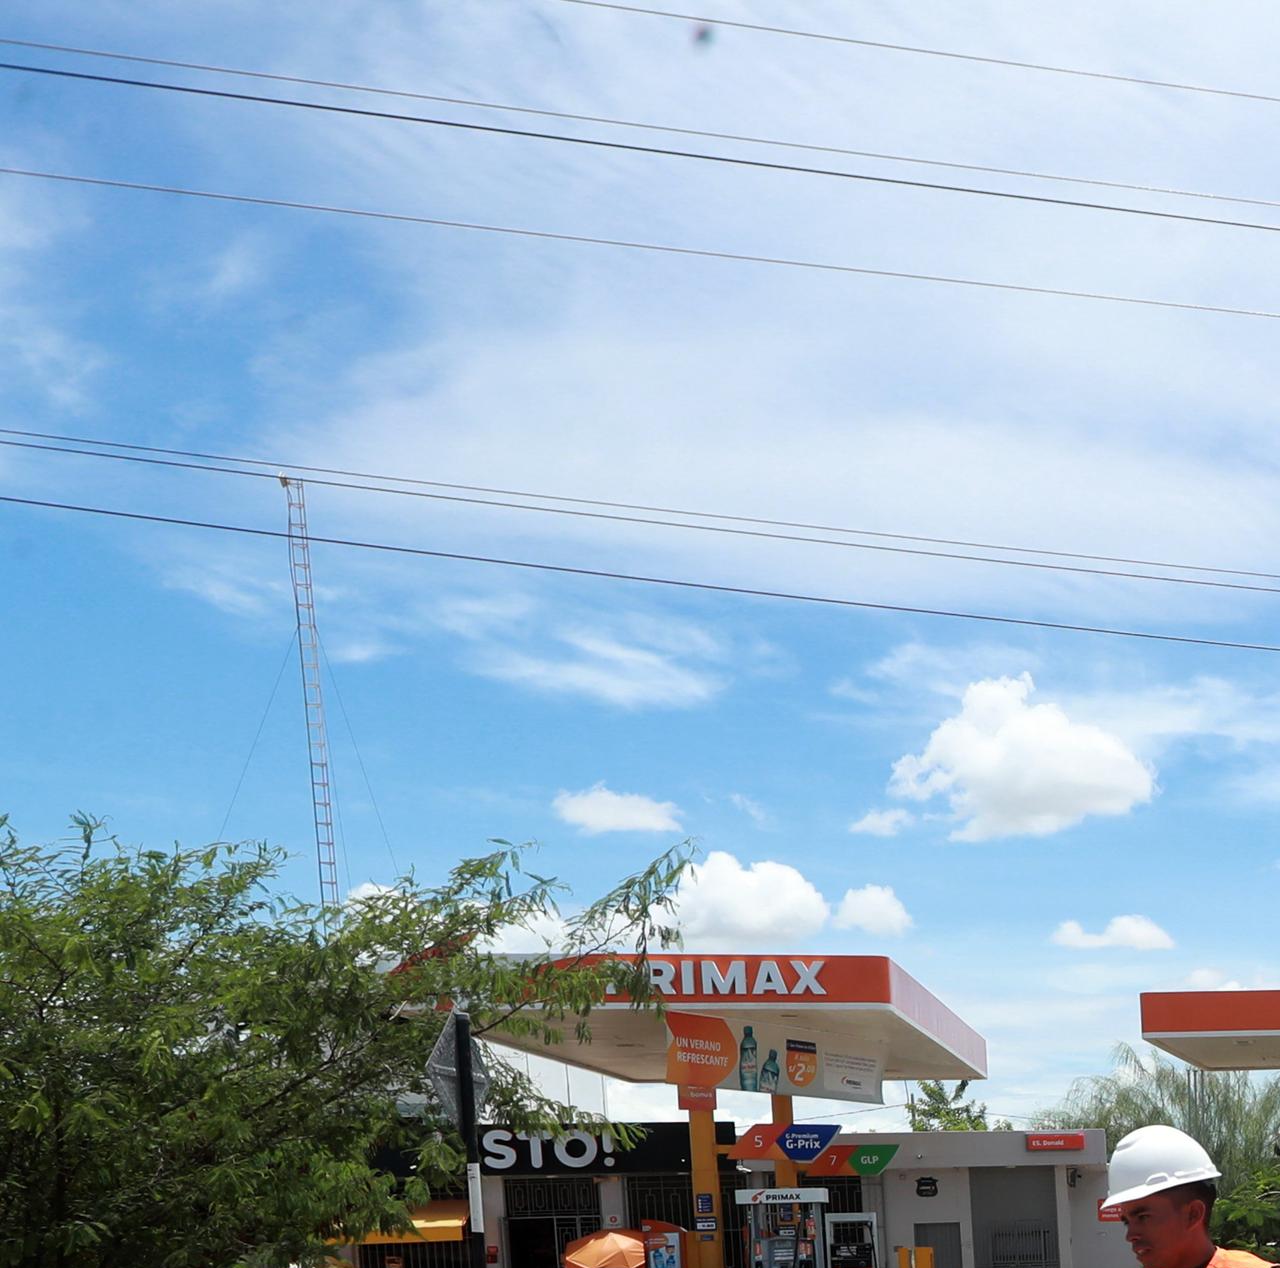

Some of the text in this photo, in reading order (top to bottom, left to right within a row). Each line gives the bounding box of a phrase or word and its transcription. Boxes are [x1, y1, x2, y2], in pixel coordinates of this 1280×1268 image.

[676, 1037, 722, 1052] UN VERANO
[676, 1051, 729, 1068] REFRESCANTE
[754, 1135, 763, 1148] 5
[785, 1139, 821, 1149] G-Prix
[482, 1129, 615, 1169] STO!
[829, 1155, 837, 1166] 7
[860, 1156, 879, 1165] GLP
[765, 1193, 801, 1201] PRIMAX
